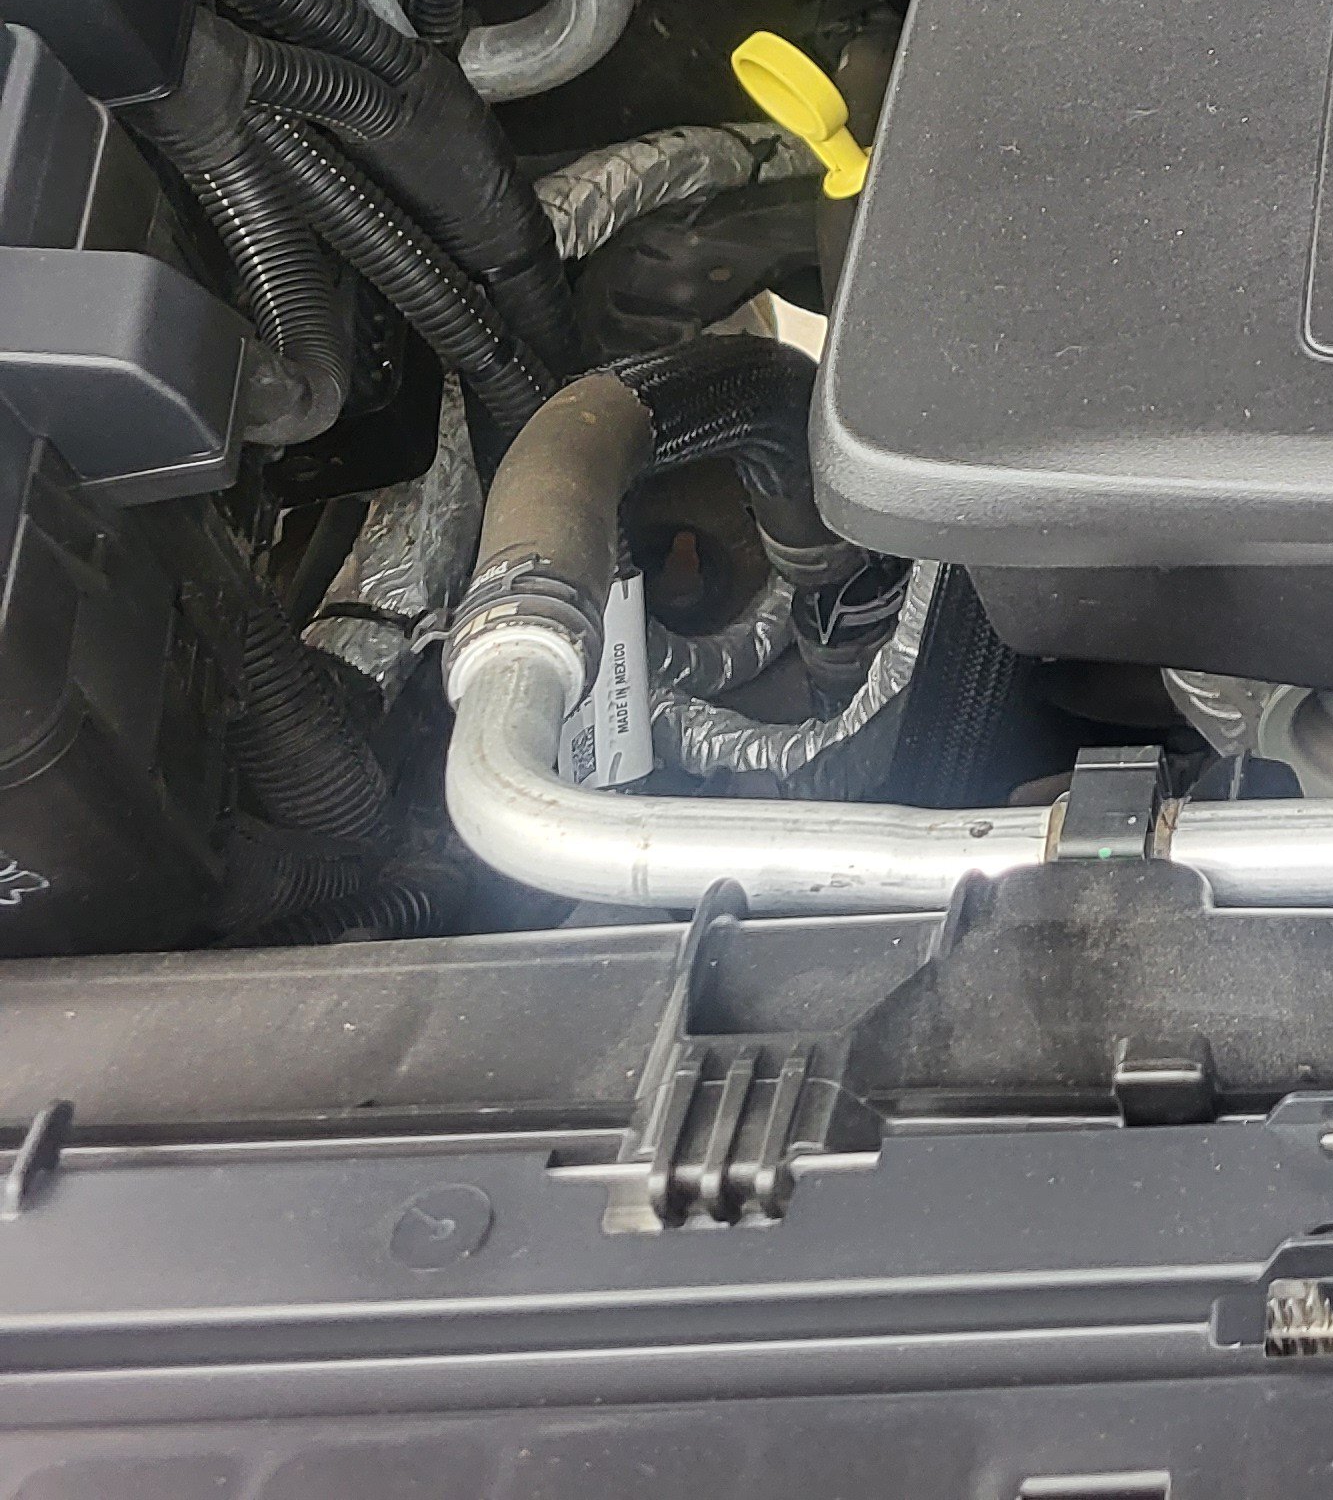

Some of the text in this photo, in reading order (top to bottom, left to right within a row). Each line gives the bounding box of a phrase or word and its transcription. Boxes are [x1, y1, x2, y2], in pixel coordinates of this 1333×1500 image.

[613, 643, 629, 734] MADE IN MEXICO
